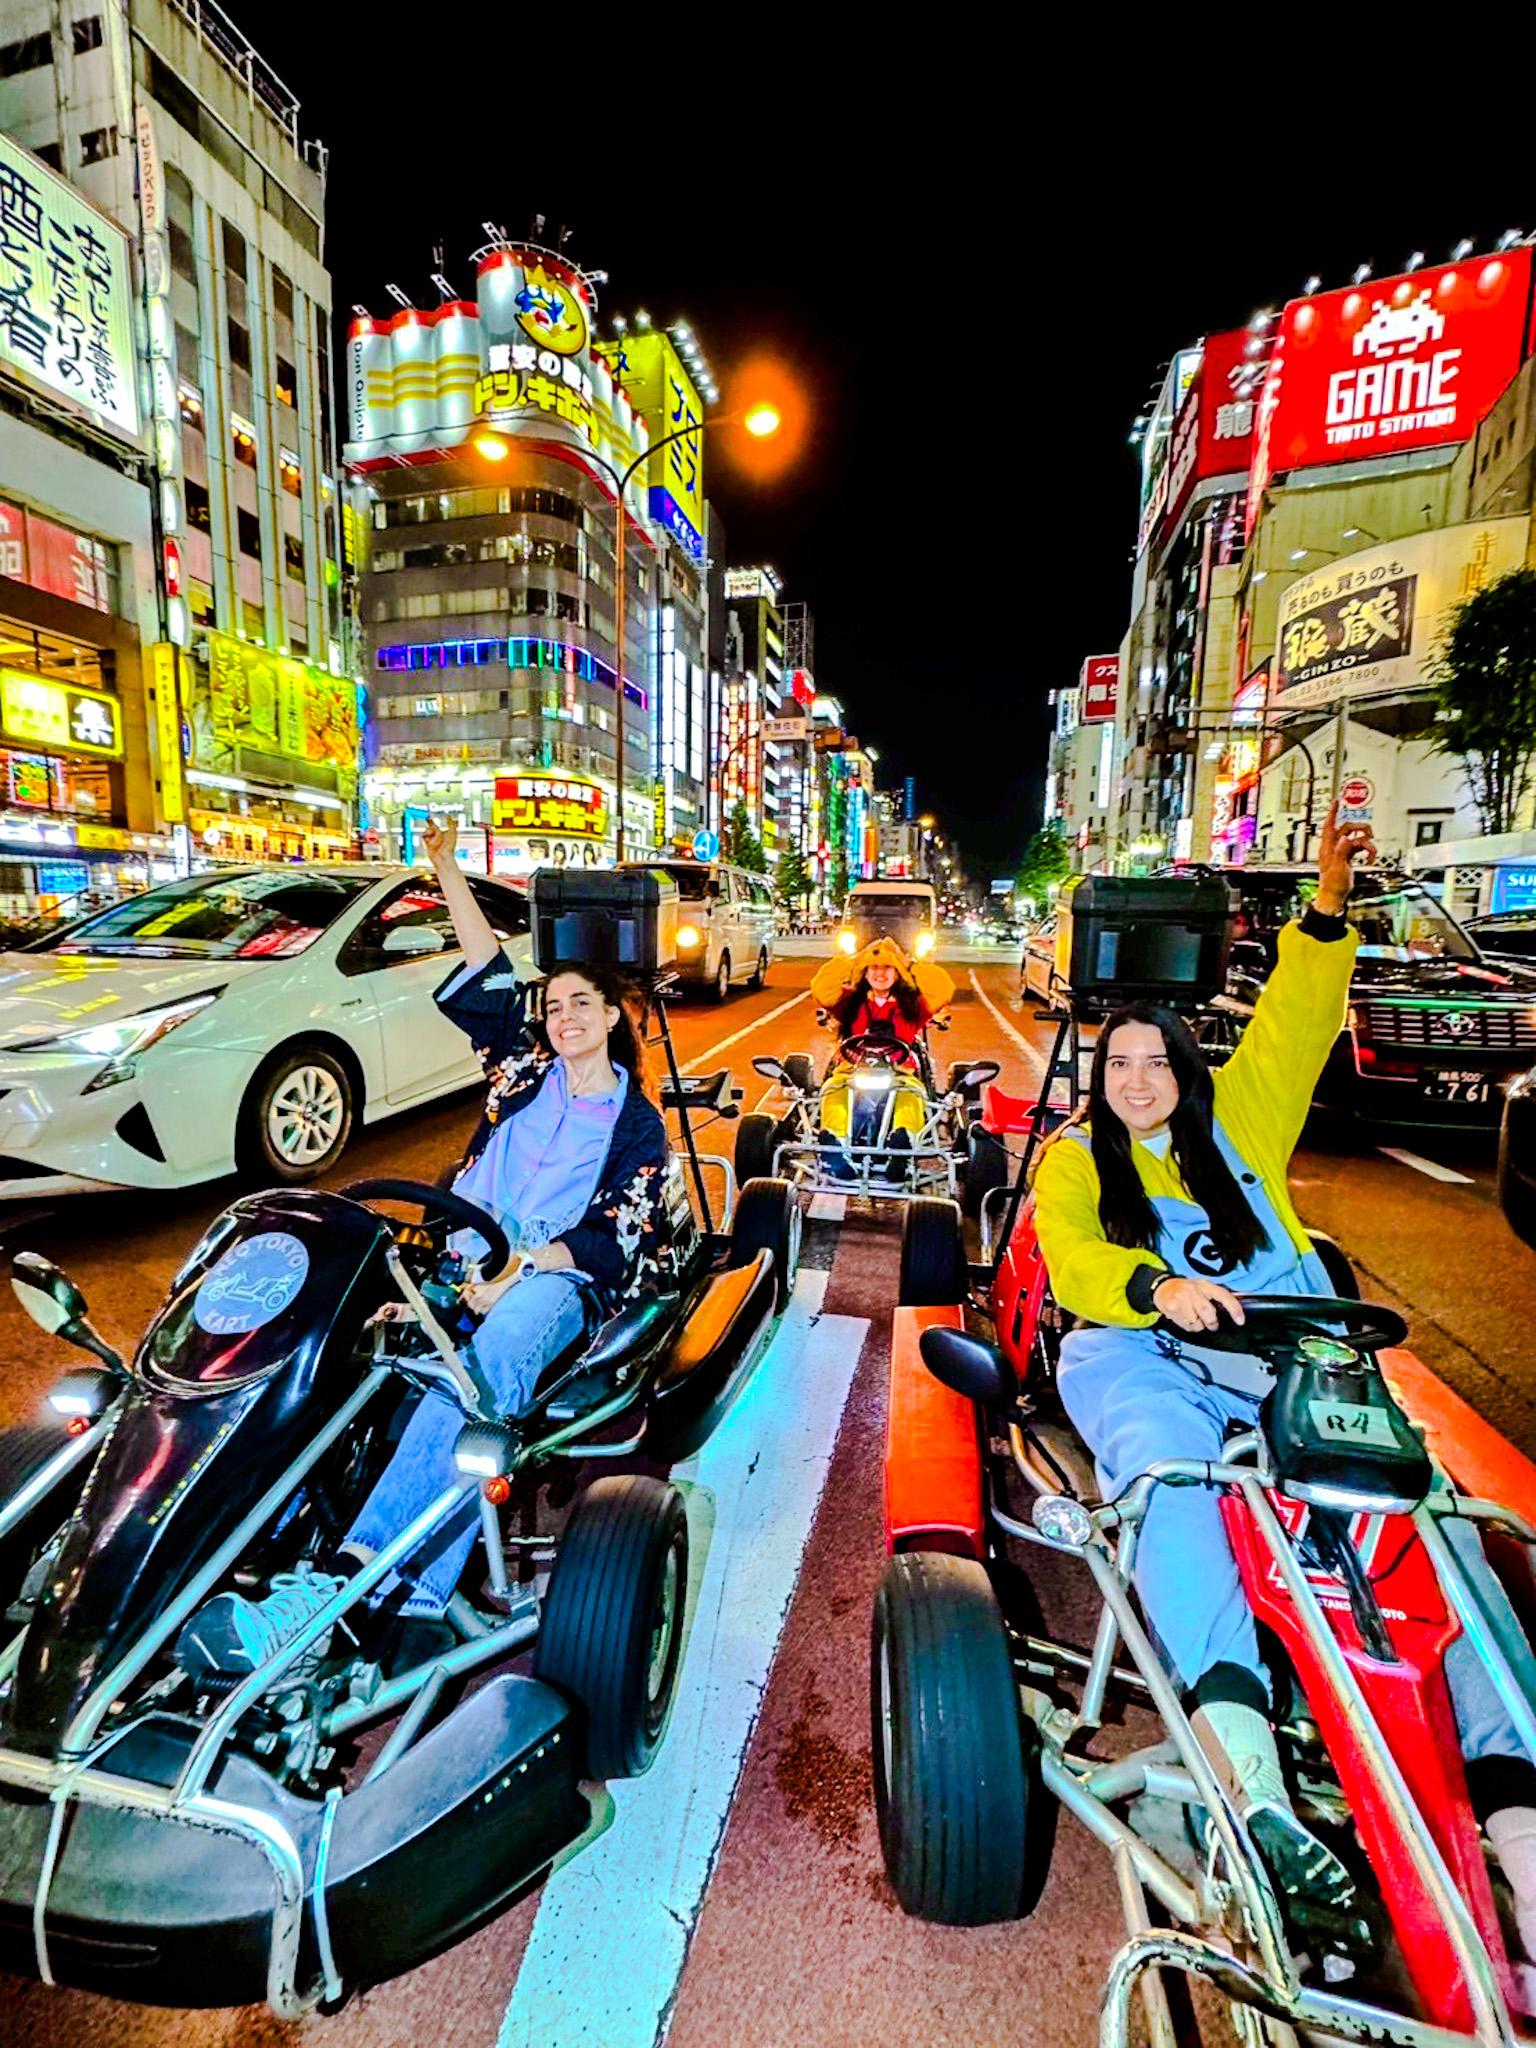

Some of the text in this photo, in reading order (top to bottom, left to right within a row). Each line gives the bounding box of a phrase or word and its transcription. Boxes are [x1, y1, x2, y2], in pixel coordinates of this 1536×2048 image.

[47, 216, 86, 386] こだわりの
[354, 341, 367, 440] Don Quijote
[1325, 348, 1462, 426] GAME
[1325, 405, 1457, 445] TAITO STATION
[1507, 873, 1536, 887] SU
[257, 1236, 304, 1269] TOKYO
[204, 1309, 253, 1332] KART
[1326, 1411, 1369, 1435] R4
